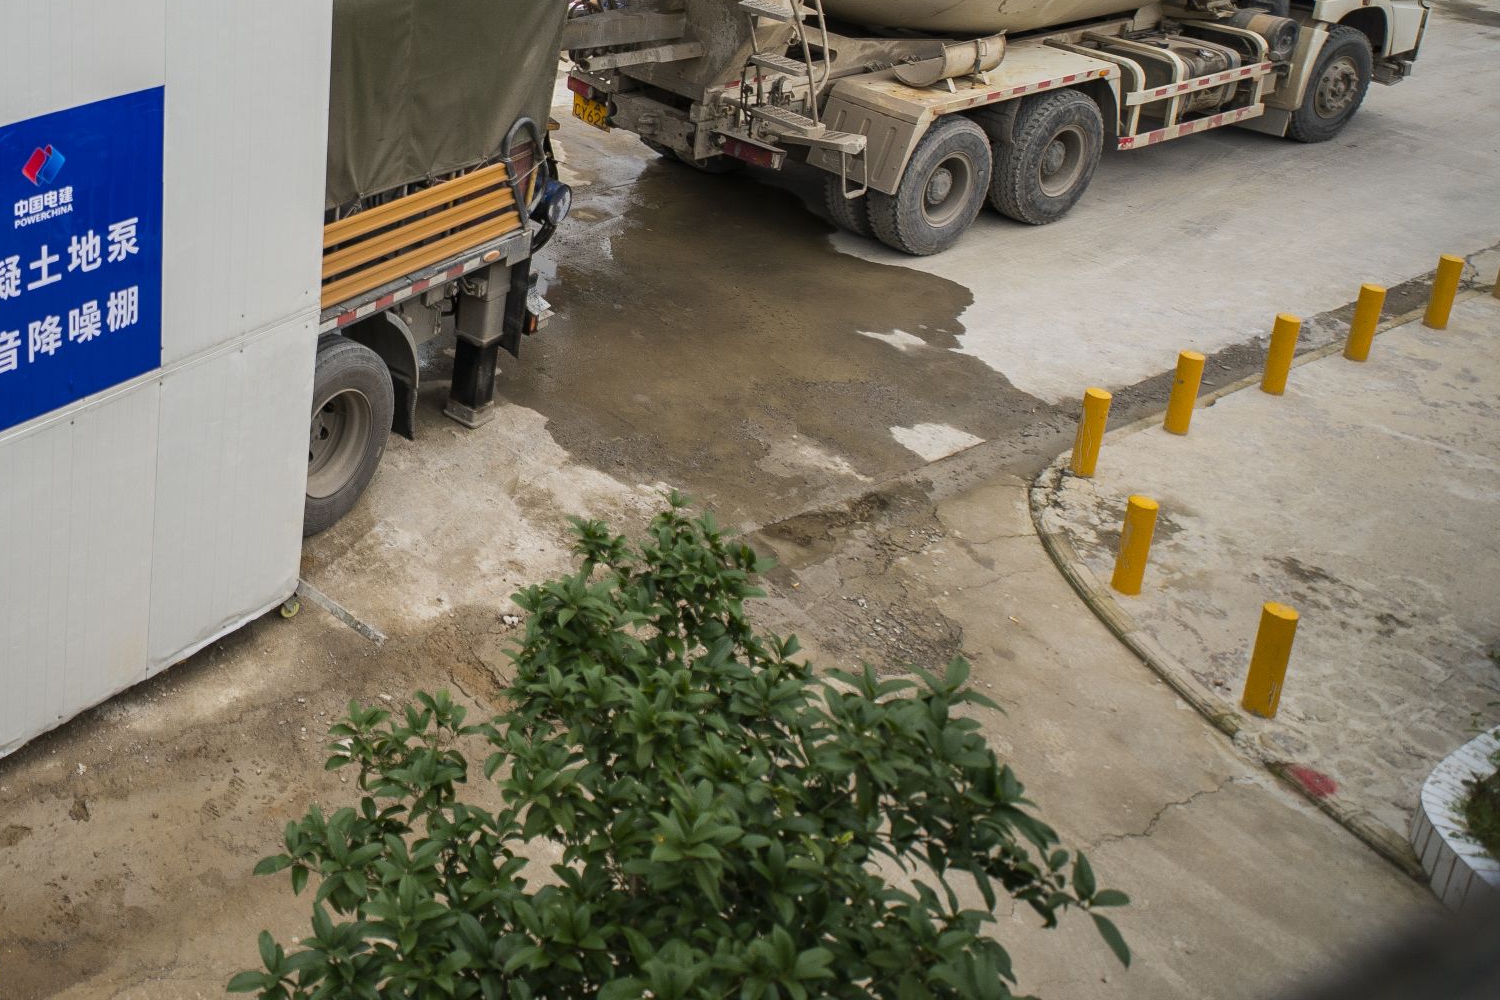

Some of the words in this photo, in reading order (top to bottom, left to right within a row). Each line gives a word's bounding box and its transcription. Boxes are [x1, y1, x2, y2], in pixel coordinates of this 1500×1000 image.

[14, 186, 73, 217] 中国电建
[14, 203, 73, 229] POWERCHINA
